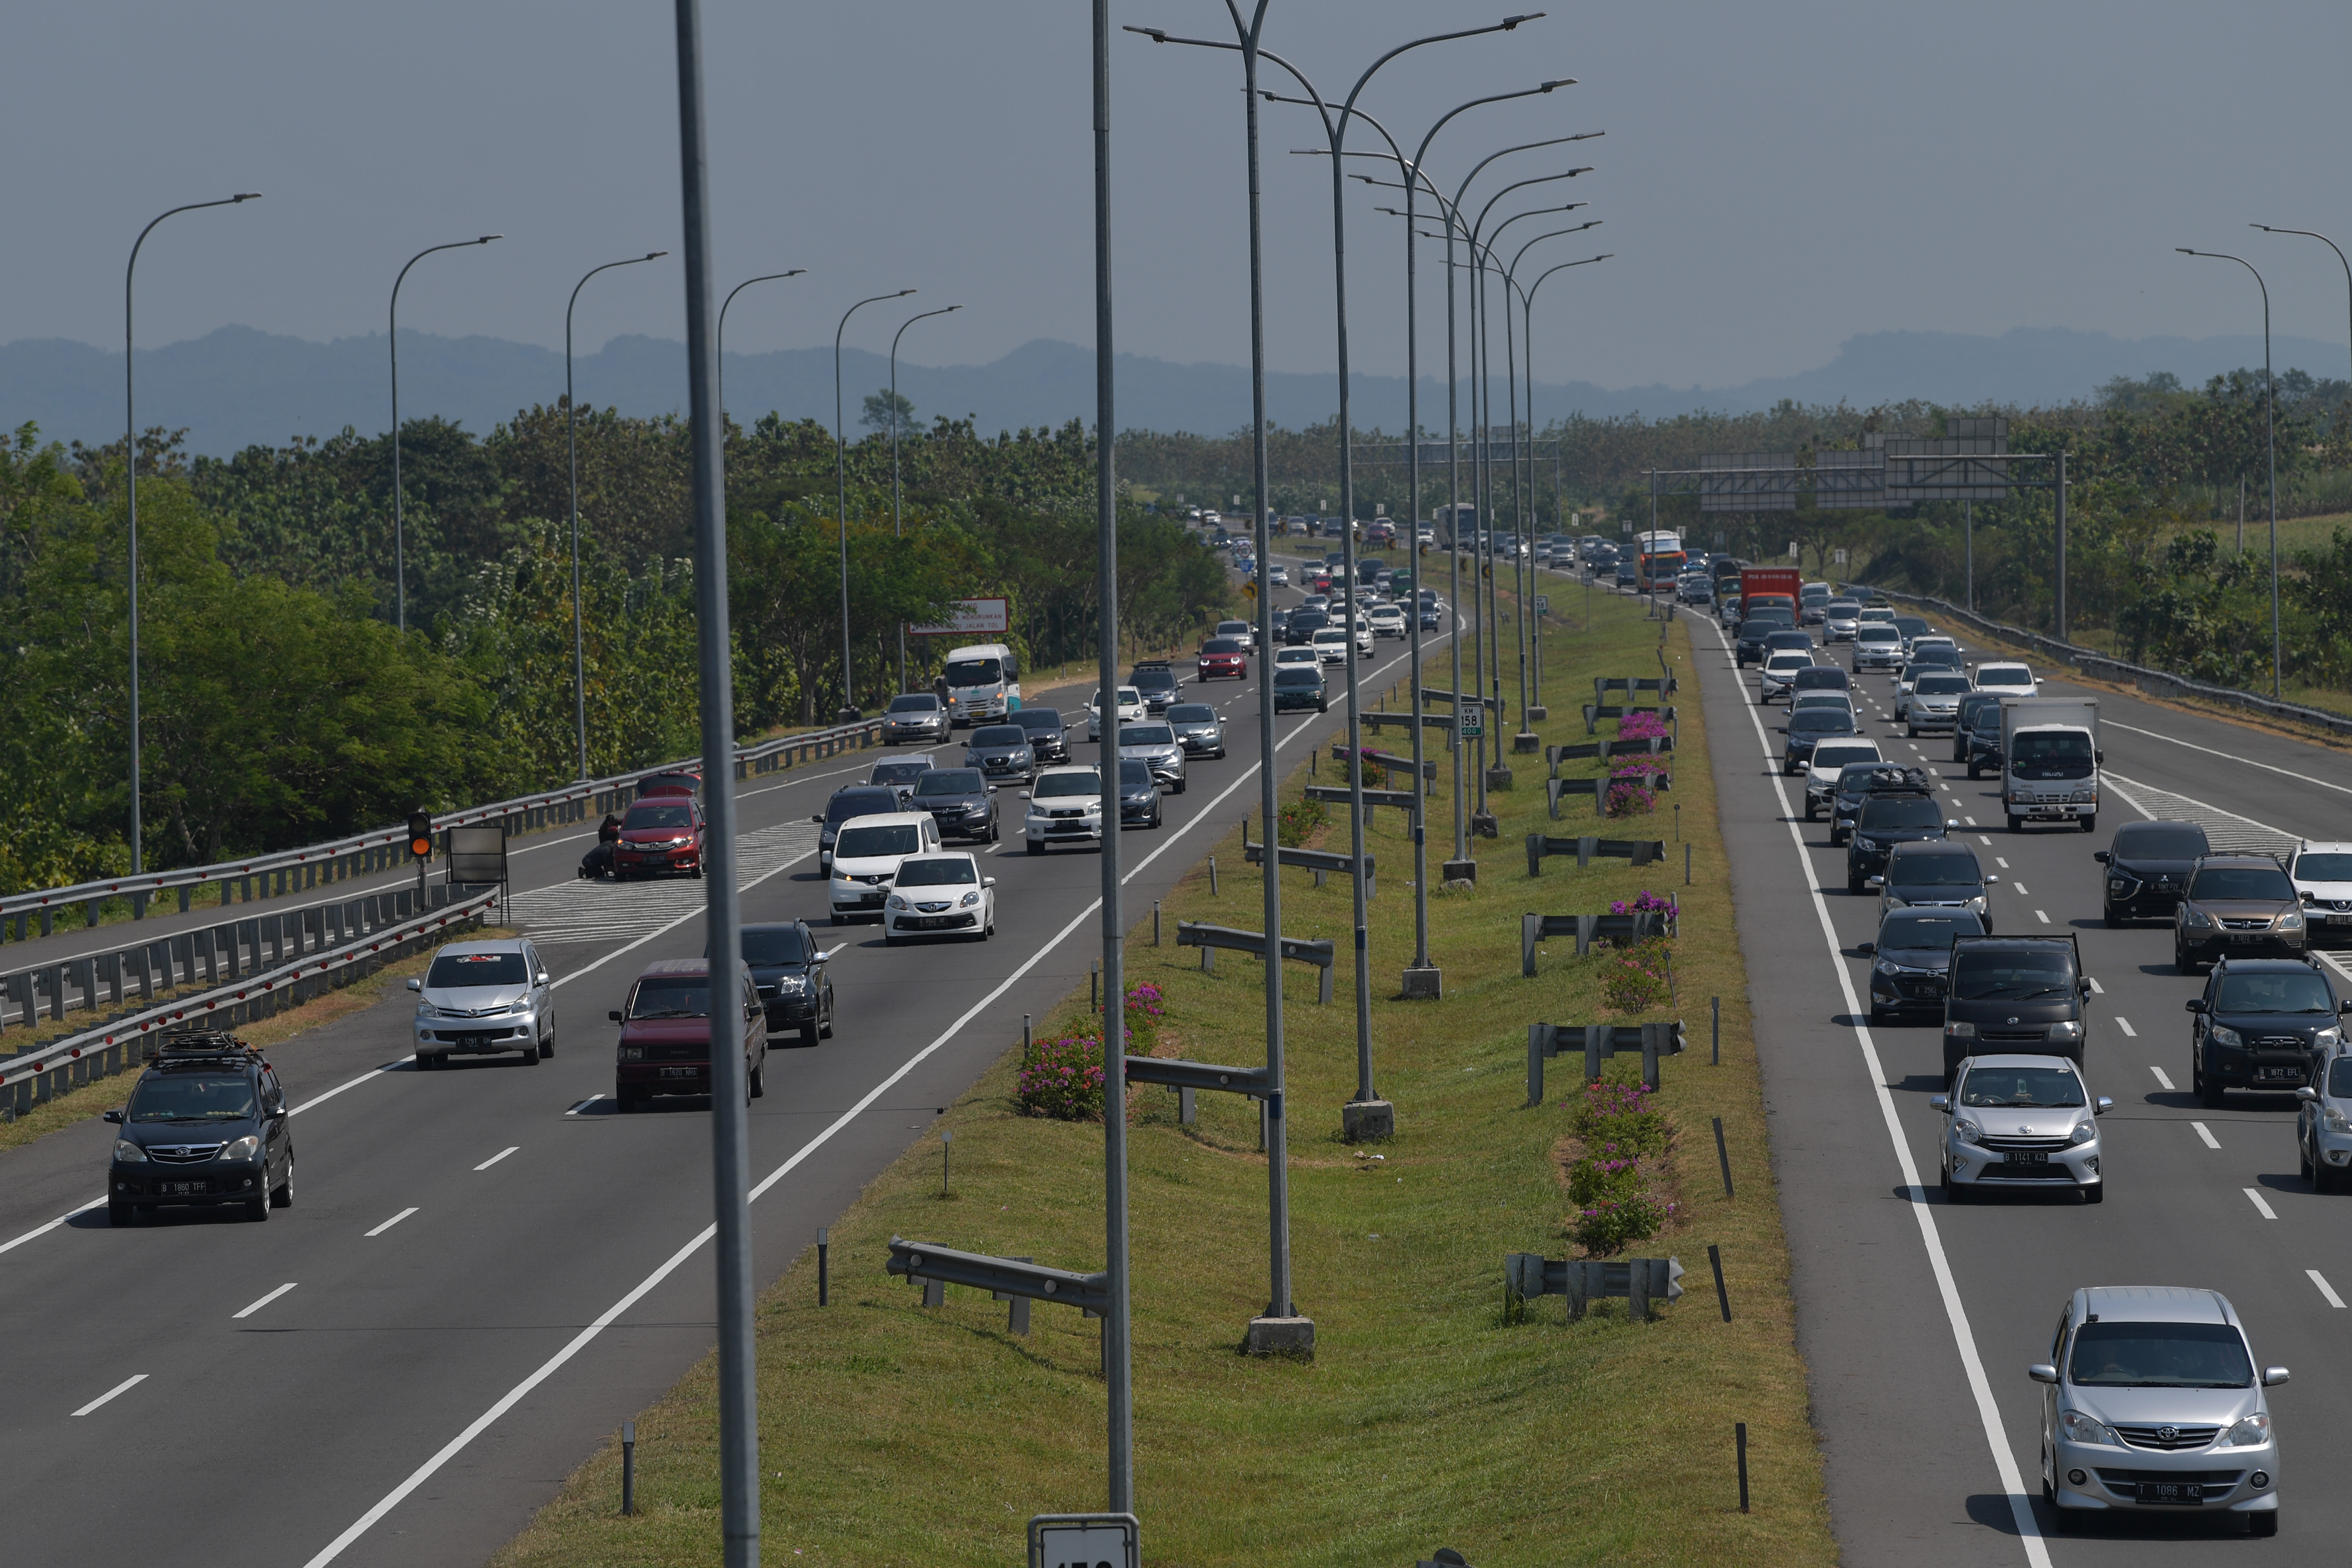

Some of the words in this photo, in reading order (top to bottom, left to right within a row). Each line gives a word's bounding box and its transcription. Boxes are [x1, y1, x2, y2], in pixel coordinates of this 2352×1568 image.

[1461, 716, 1477, 726] 158
[2006, 1153, 2010, 1161] B
[2014, 1153, 2029, 1161] 1141
[2035, 1153, 2047, 1161] KZL
[162, 1184, 167, 1192] B
[174, 1183, 189, 1192] 1860
[193, 1182, 205, 1191] TFF
[2139, 1484, 2144, 1495] T
[2156, 1485, 2178, 1496] 1086
[2187, 1486, 2200, 1497] MZ
